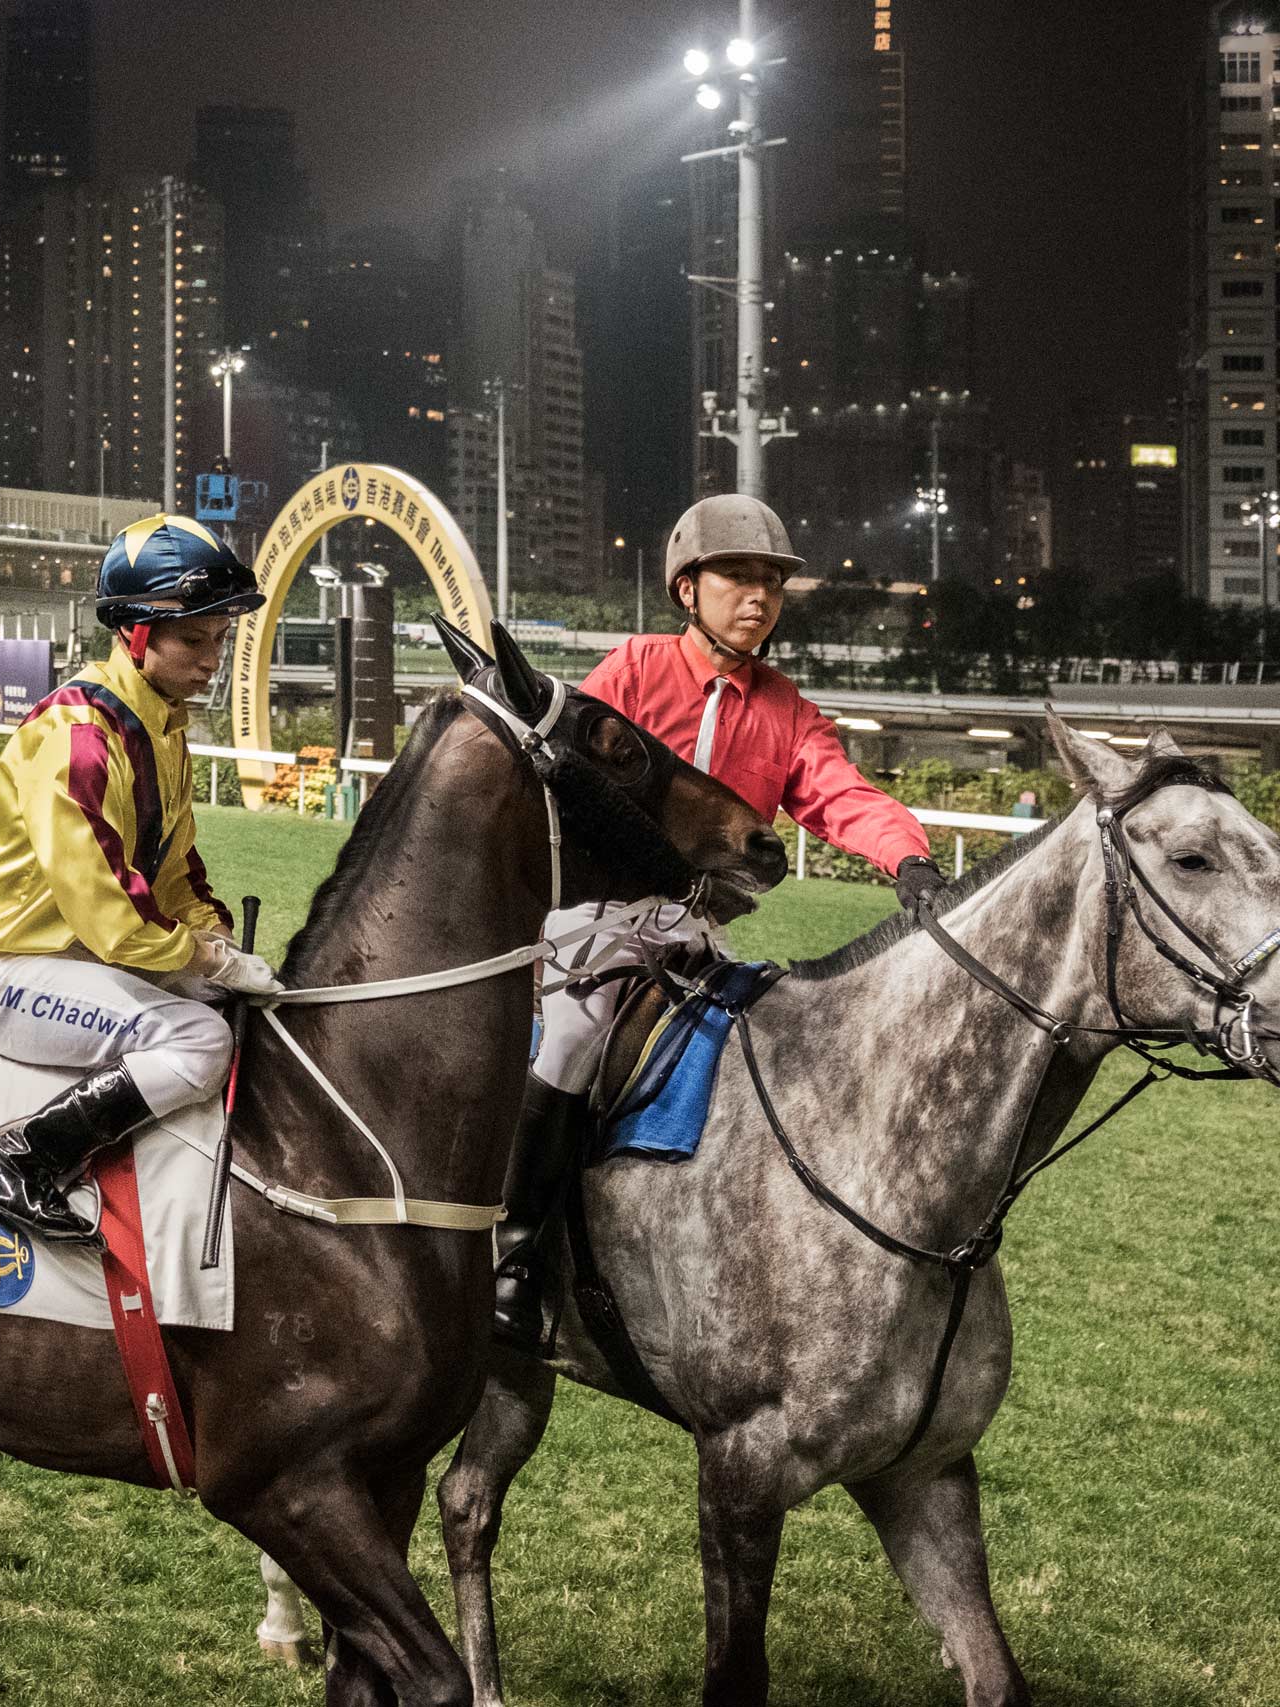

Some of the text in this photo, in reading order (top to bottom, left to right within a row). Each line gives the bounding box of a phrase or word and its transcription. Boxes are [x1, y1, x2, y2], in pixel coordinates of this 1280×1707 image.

[366, 478, 431, 545] 香港賽馬會
[429, 537, 448, 570] The
[442, 564, 463, 610] Hong
[240, 632, 256, 682] Valley
[241, 687, 251, 737] Happy
